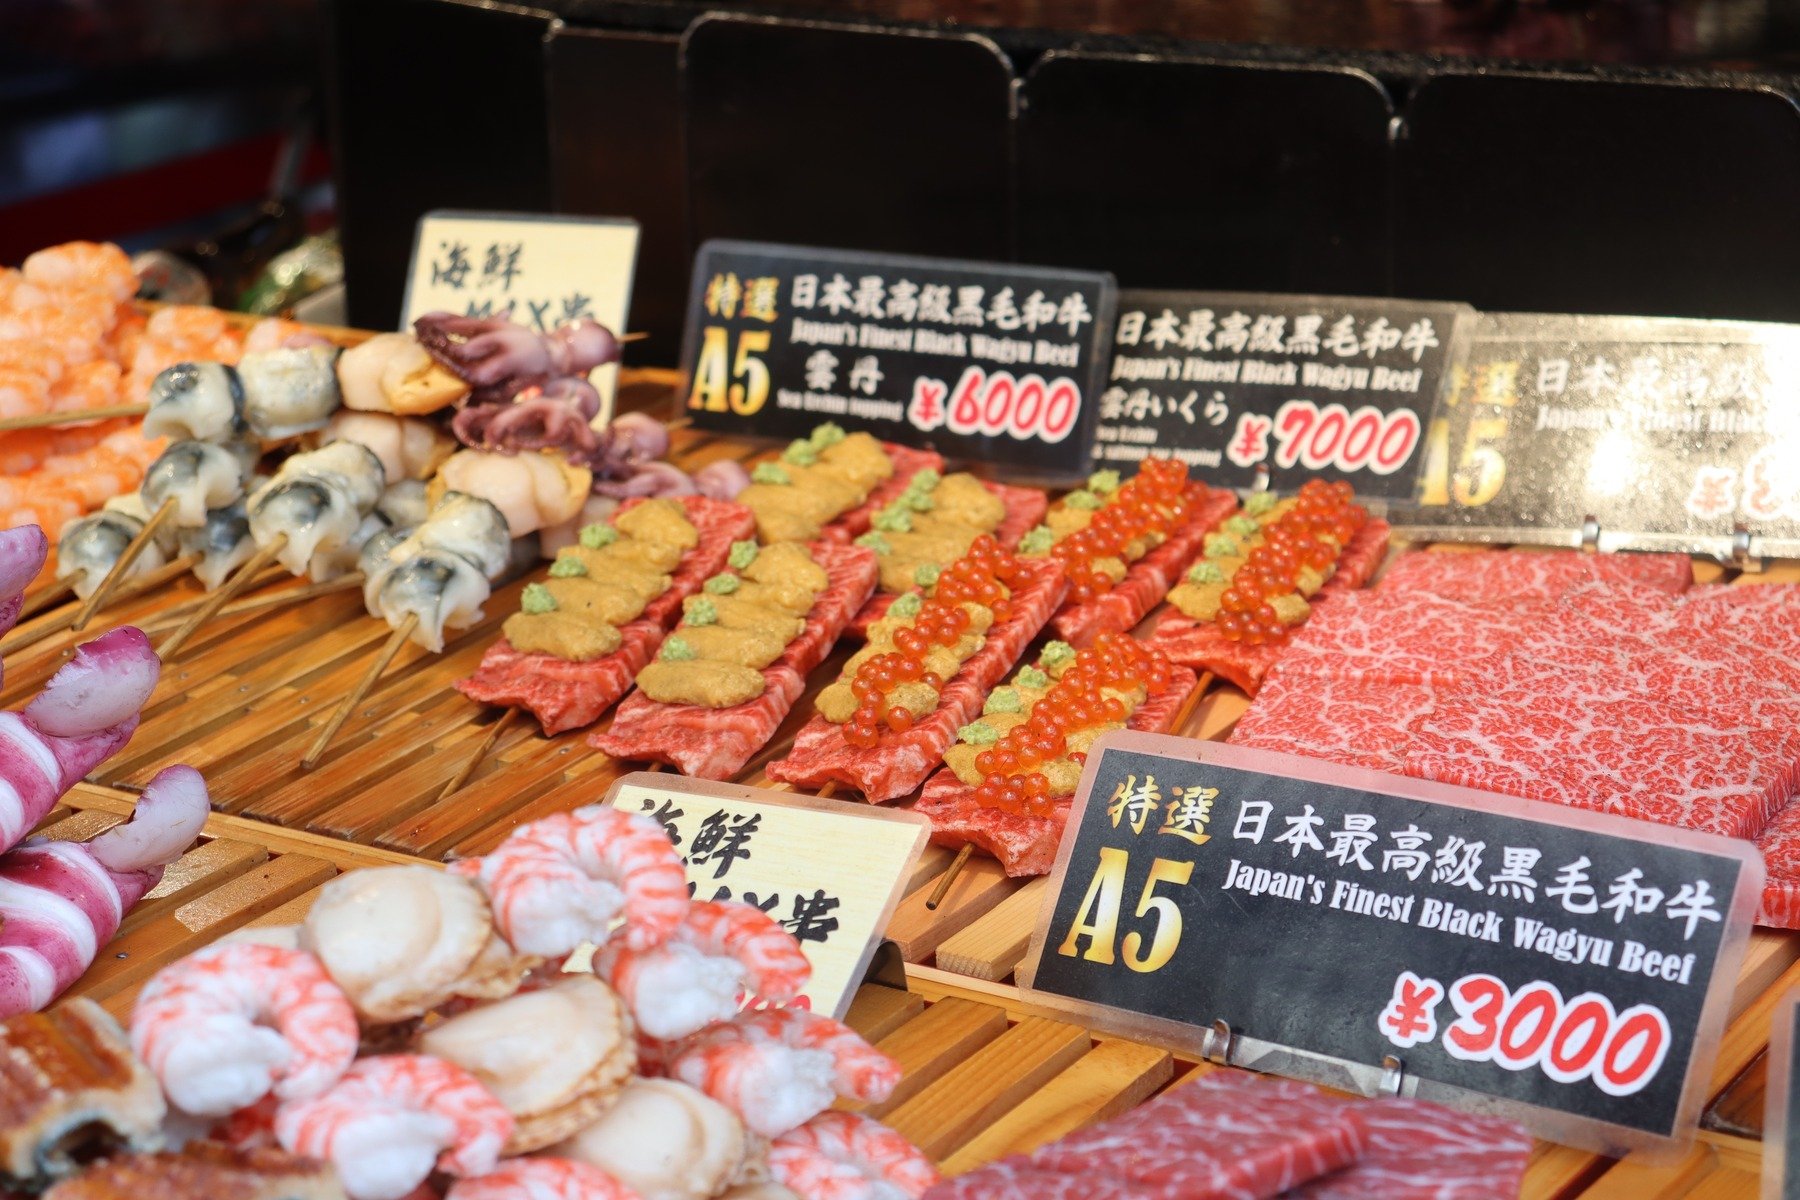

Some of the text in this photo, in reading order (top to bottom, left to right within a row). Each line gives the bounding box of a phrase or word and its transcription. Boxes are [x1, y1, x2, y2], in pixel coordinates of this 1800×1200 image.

[432, 241, 523, 290] 海鮮
[705, 272, 779, 323] 特選
[791, 274, 1092, 337] 日本最高級黒毛和牛
[1116, 308, 1439, 363] 日本最高級黒毛和牛
[689, 326, 771, 416] A5
[789, 317, 1081, 368] Japan's Finest Black Wagyu Beef
[805, 349, 884, 396] 雲丹
[1182, 357, 1240, 383] Finest
[1240, 360, 1298, 386] Black
[1302, 362, 1370, 390] Wagyu
[1370, 366, 1423, 392] Beef
[908, 365, 1081, 443] ¥6000
[1227, 400, 1420, 475] ¥7000
[1107, 774, 1221, 847] 特選
[1230, 799, 1722, 942] 日本最高級黒毛和牛
[1058, 846, 1196, 975] A5
[1221, 859, 1696, 985] Japan's Finest Black Wagyu Beef
[1378, 970, 1672, 1097] ¥3000
